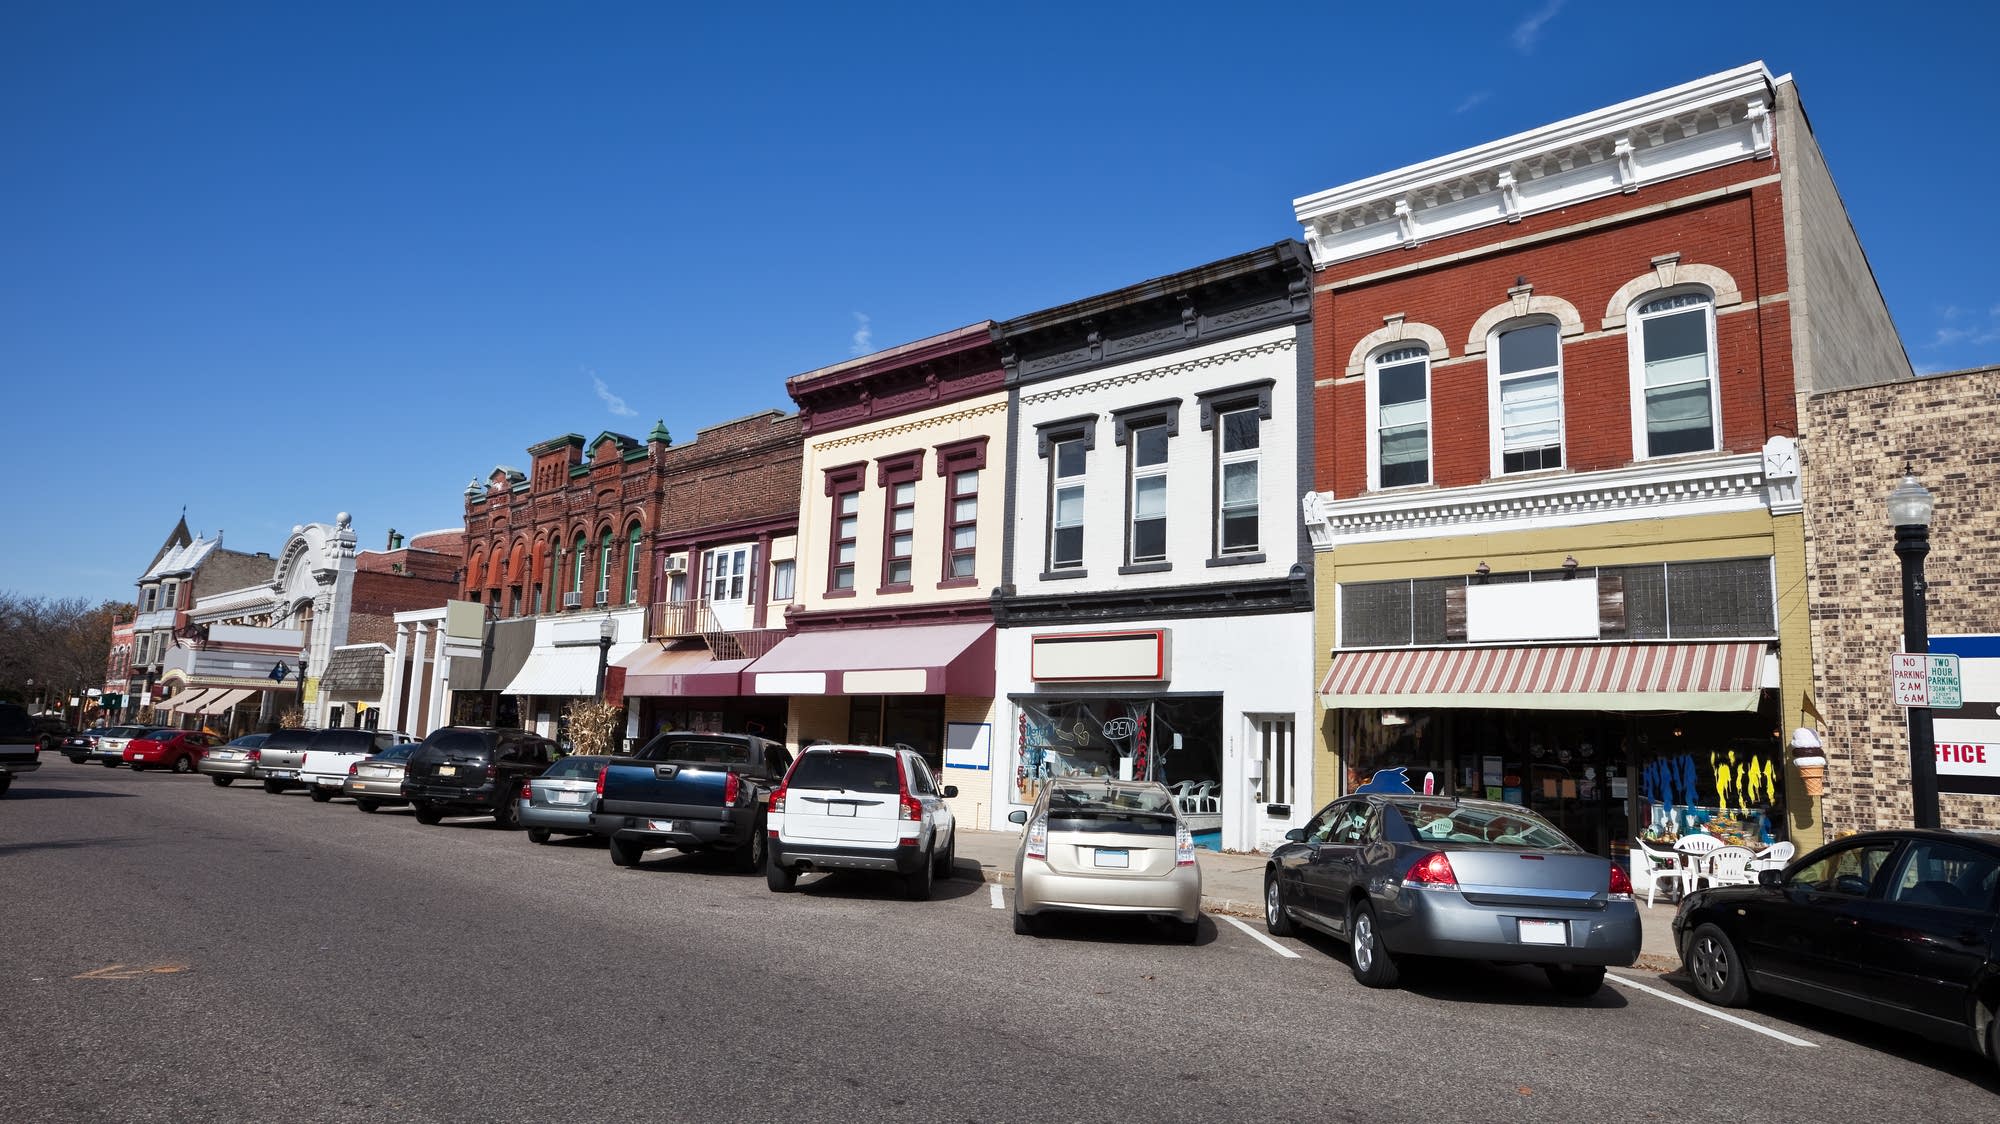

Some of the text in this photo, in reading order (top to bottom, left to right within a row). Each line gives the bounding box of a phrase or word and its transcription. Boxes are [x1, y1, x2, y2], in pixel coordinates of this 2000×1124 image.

[1903, 658, 1916, 667] NO
[1934, 658, 1950, 667] TWO
[1894, 670, 1925, 680] PARKING
[1931, 667, 1953, 677] HOUR
[1927, 676, 1958, 686] PARKING
[1900, 682, 1922, 691] 2 AM
[1911, 694, 1925, 703] AM
[1103, 721, 1134, 735] OPEN
[1136, 714, 1147, 781] KARAT
[1935, 744, 1986, 763] FFICE
